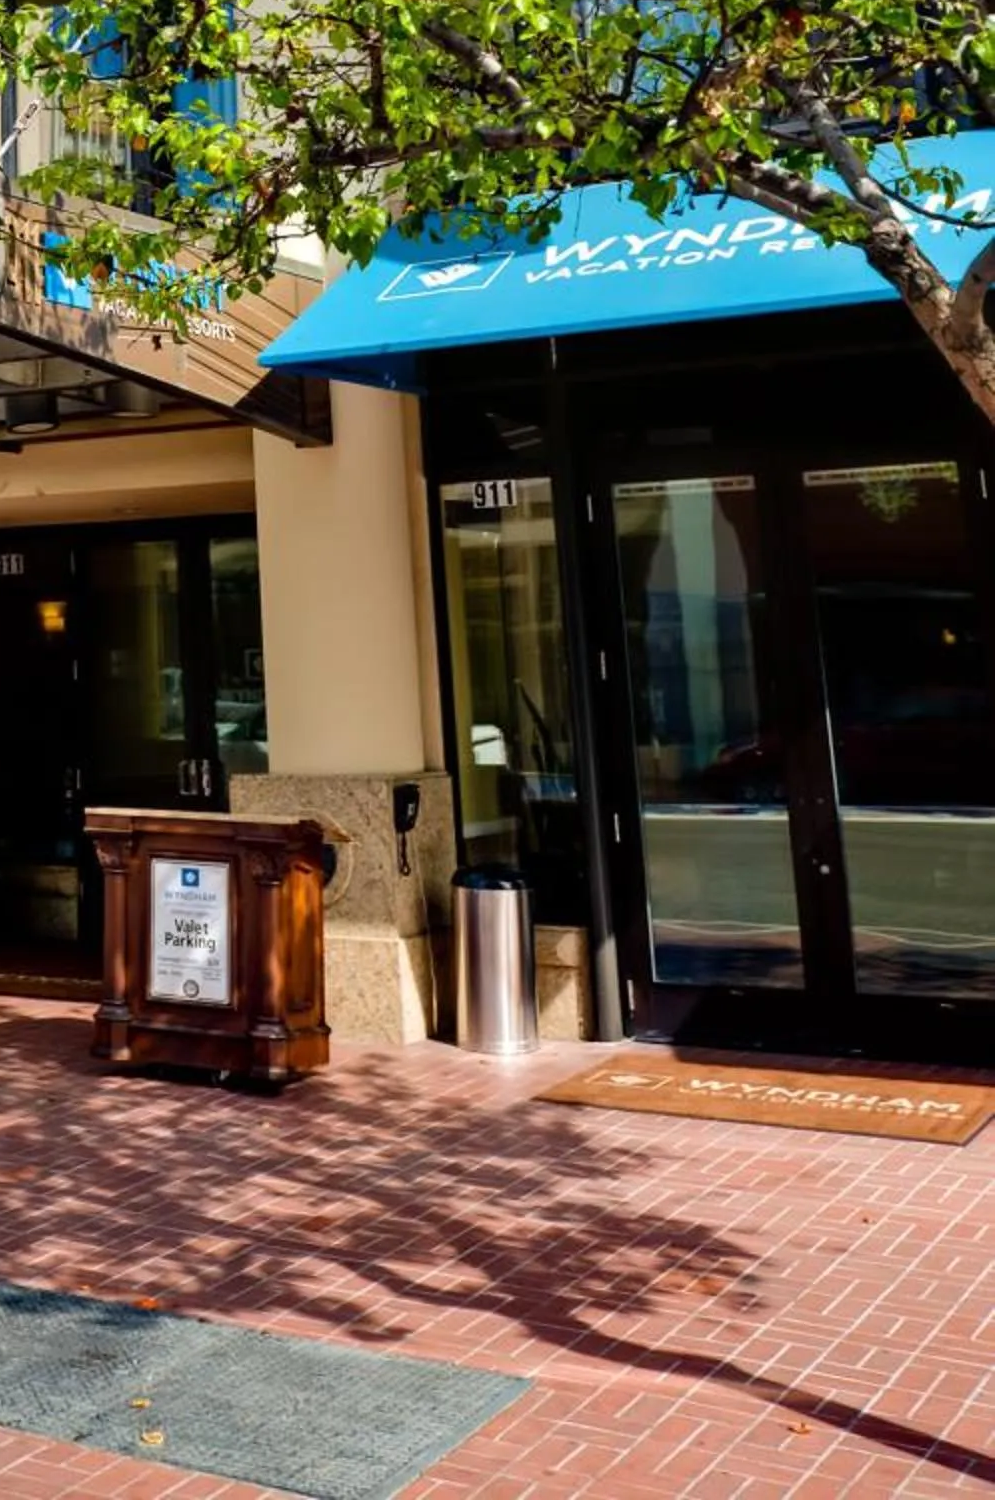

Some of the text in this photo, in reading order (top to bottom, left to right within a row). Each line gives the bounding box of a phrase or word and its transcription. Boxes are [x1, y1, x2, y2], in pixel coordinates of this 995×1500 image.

[545, 189, 992, 267] WYNDM
[525, 245, 738, 284] VACATION
[474, 481, 514, 507] 911
[174, 917, 209, 935] Valet
[164, 931, 216, 953] Parking
[690, 1078, 962, 1113] WYNDHAM
